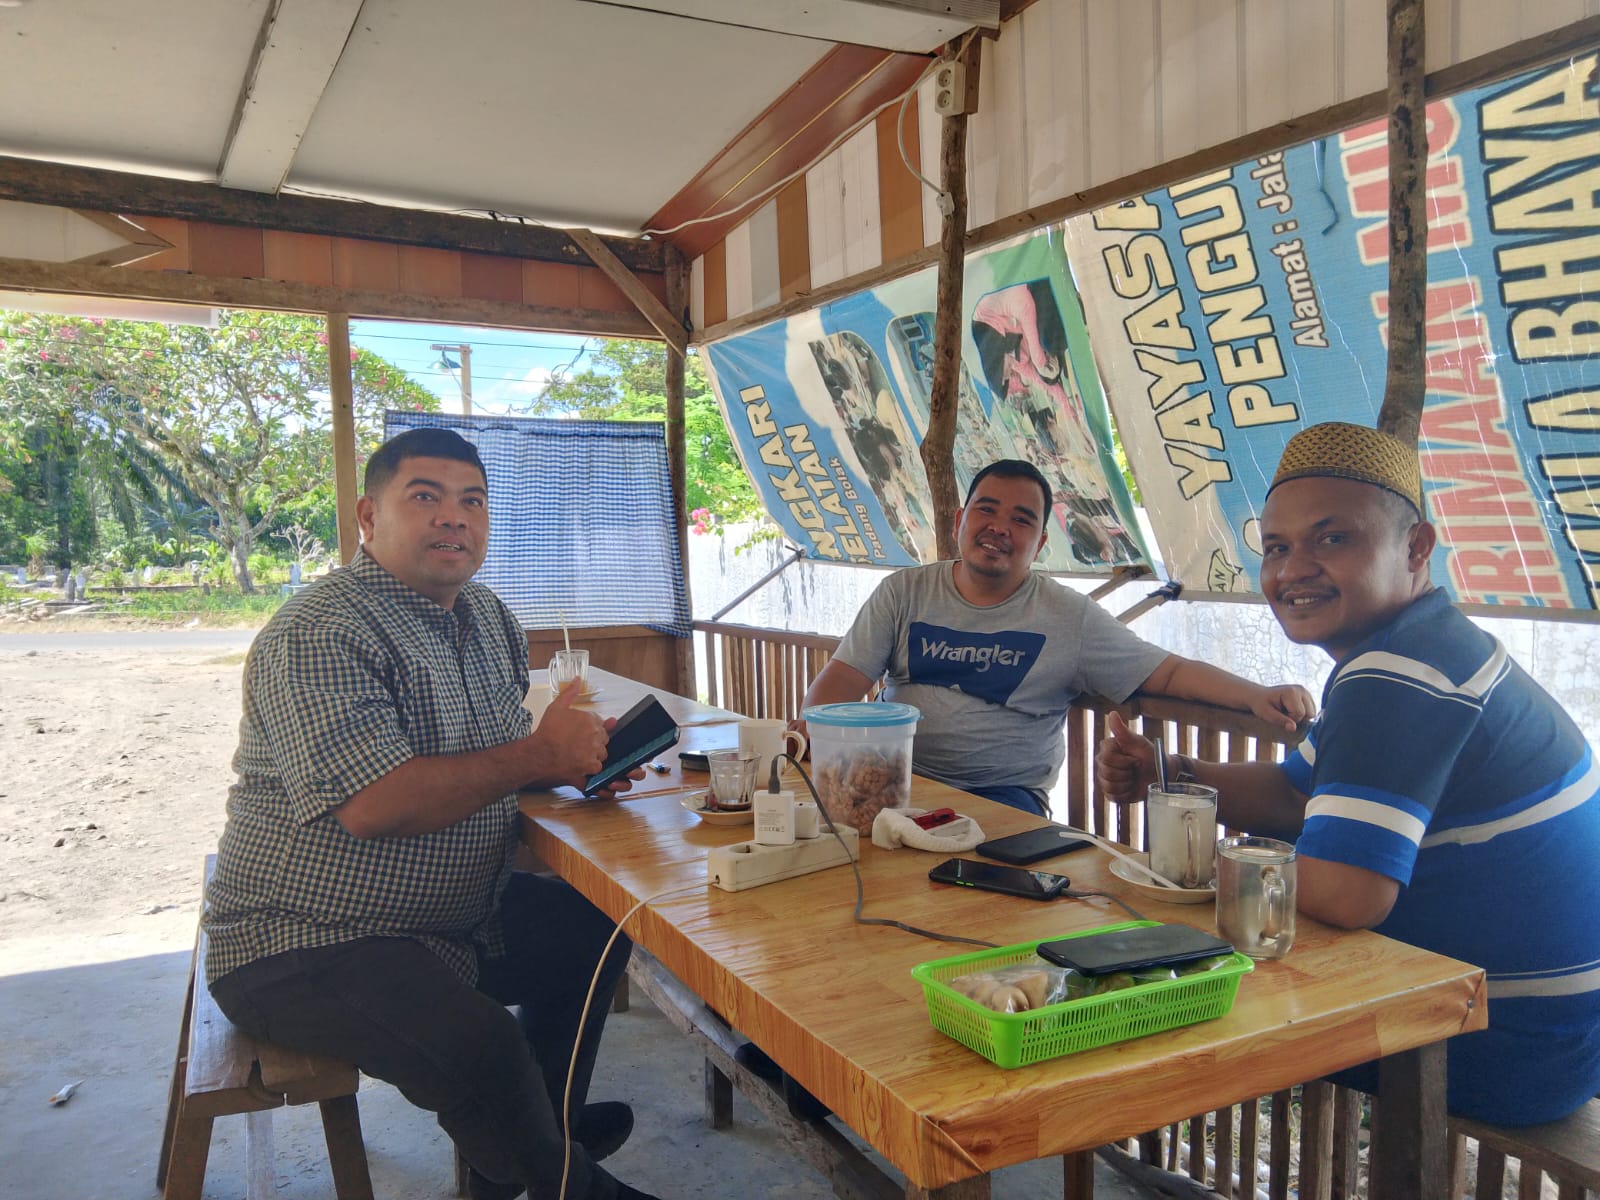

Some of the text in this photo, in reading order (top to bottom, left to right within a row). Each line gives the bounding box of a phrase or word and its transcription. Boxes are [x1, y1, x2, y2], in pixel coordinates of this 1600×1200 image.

[1270, 238, 1329, 348] Alamat
[739, 384, 844, 560] NGKARI
[829, 457, 886, 560] Padang Bolak
[921, 636, 1026, 673] Wrangler
